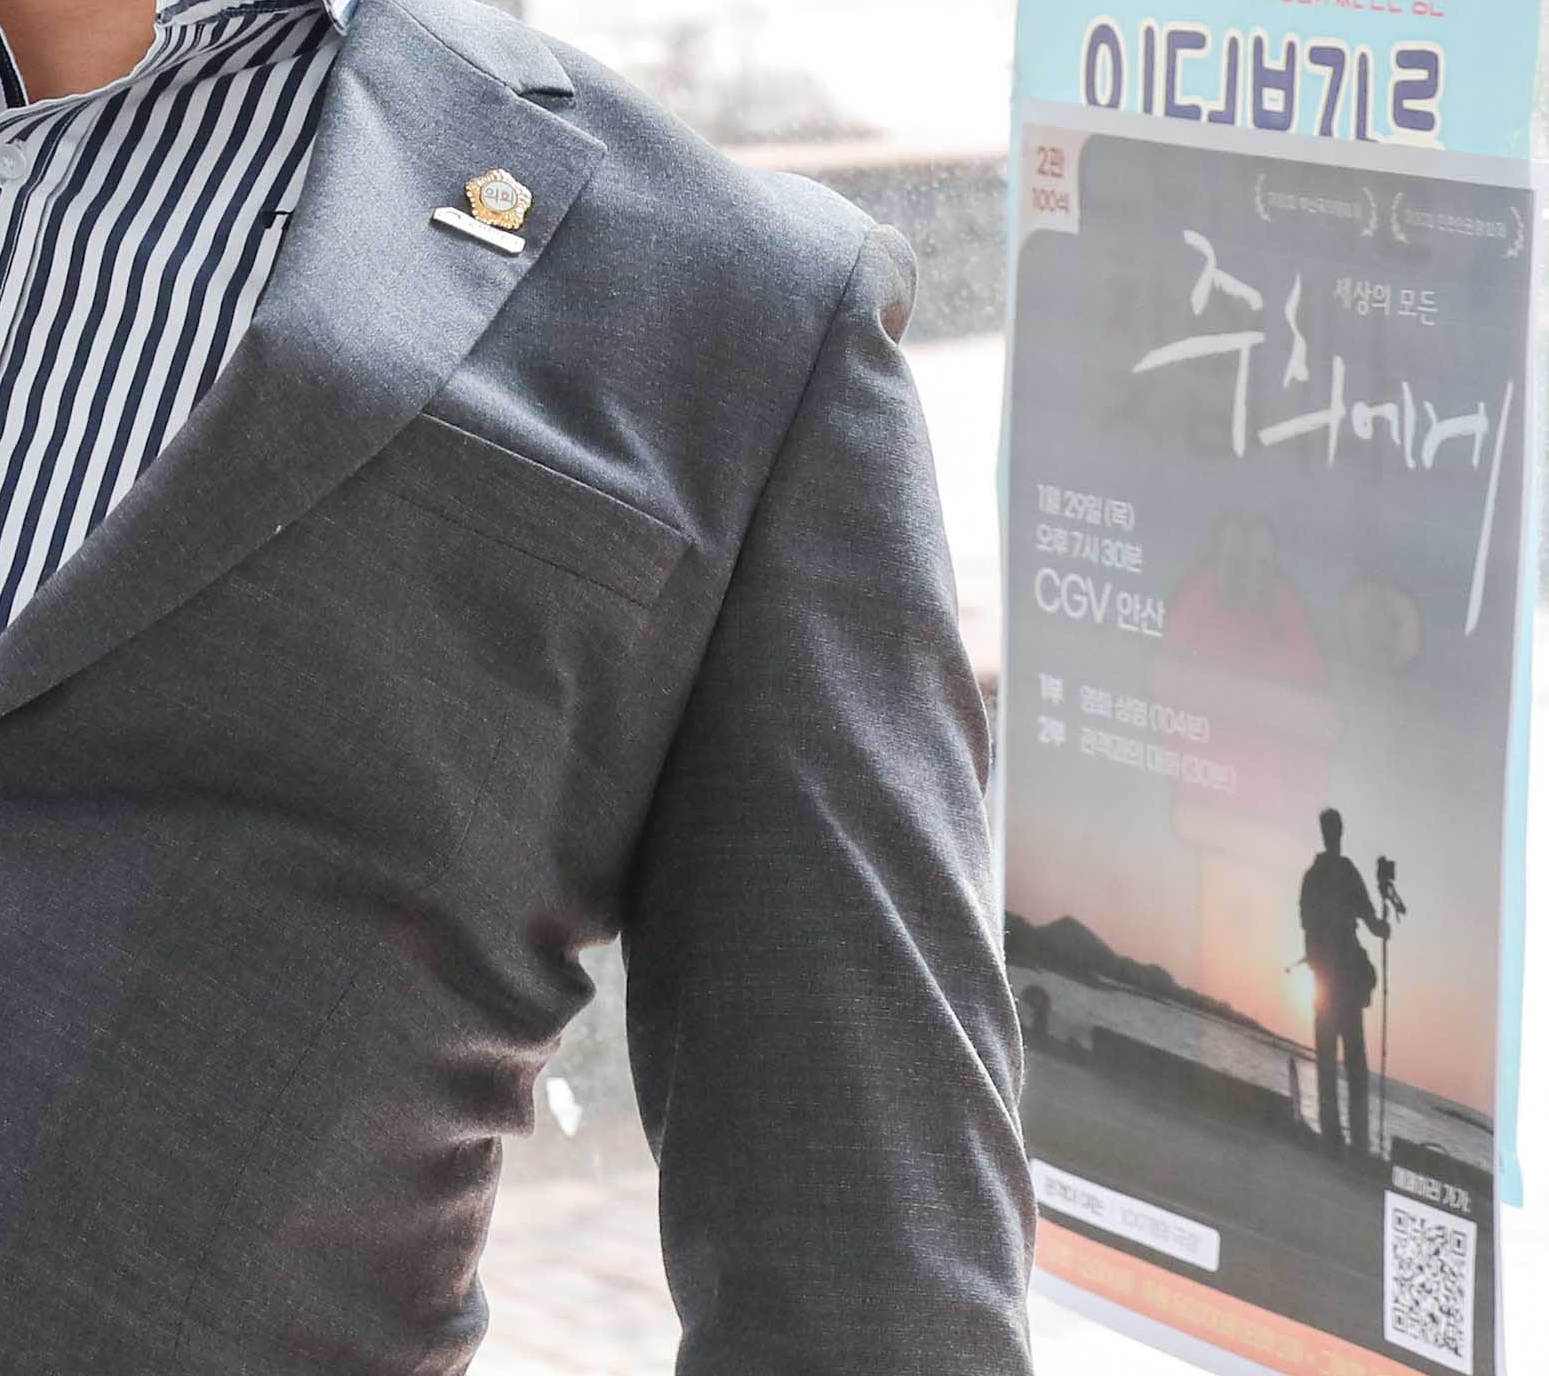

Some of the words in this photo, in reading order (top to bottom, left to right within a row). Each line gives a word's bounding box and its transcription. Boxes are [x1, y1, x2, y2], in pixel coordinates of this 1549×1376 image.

[1333, 276, 1391, 317] 세상의
[1398, 289, 1440, 327] 모든
[1034, 566, 1112, 624] CGV
[1116, 591, 1165, 637] 안산
